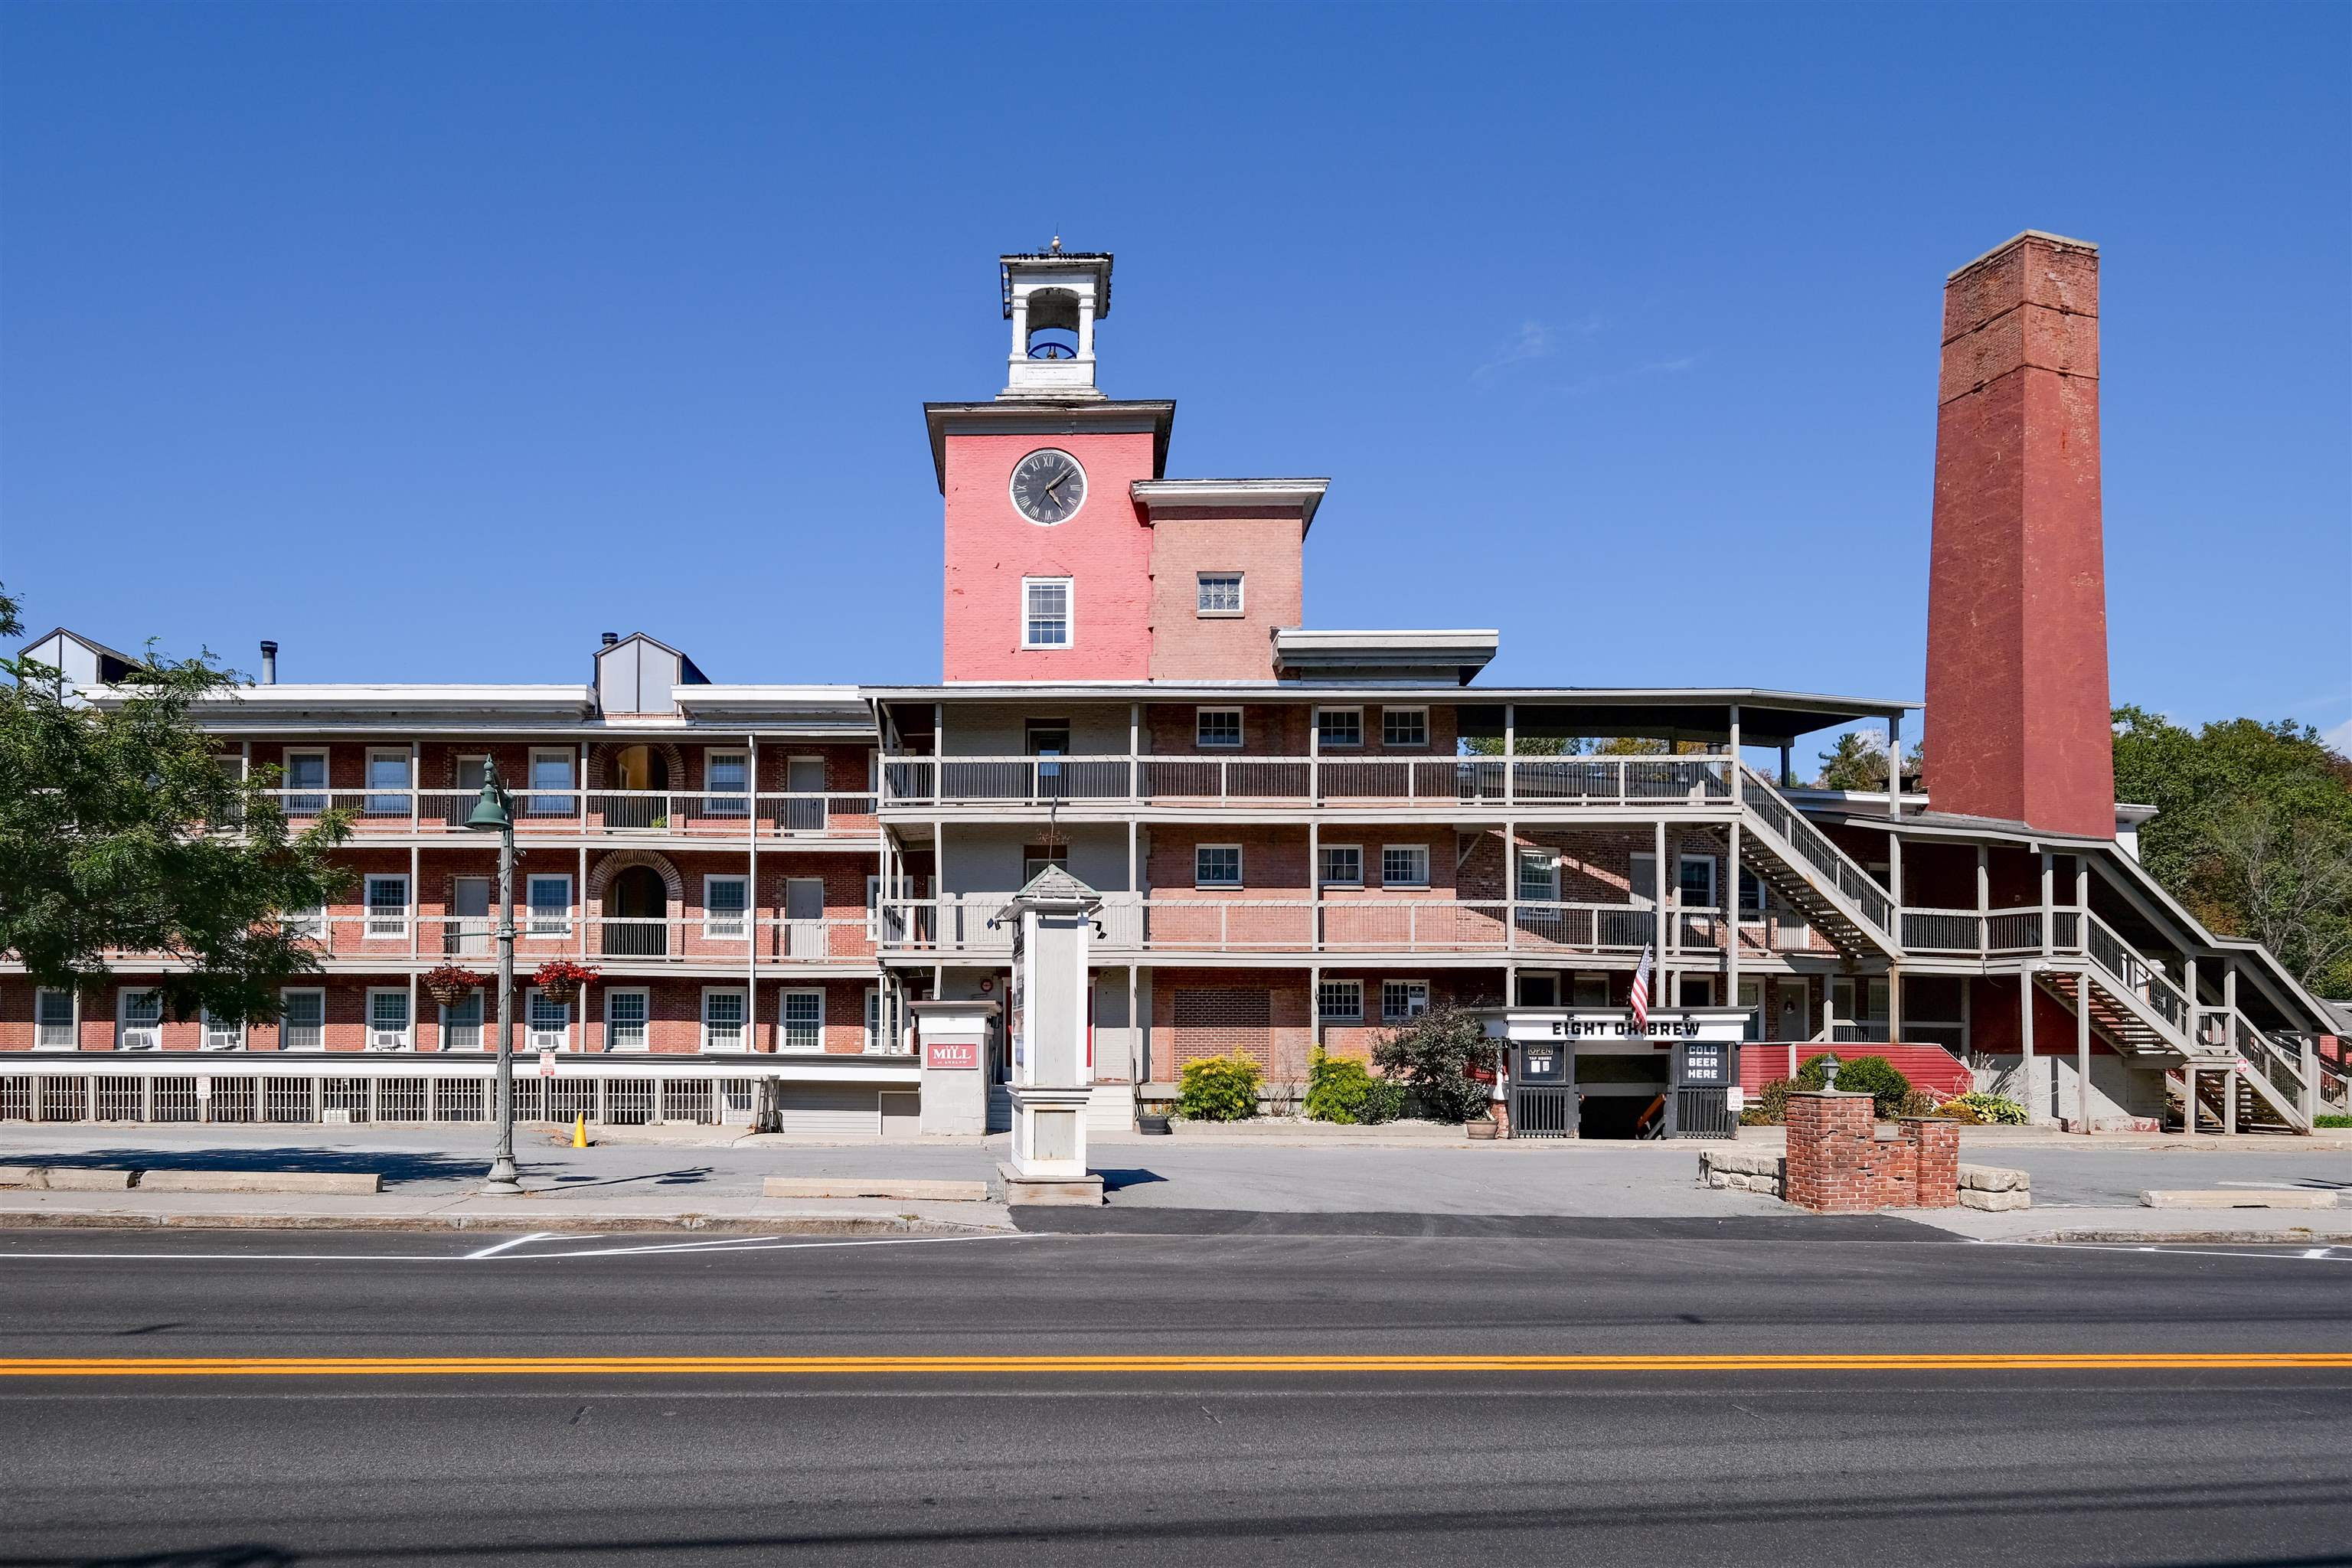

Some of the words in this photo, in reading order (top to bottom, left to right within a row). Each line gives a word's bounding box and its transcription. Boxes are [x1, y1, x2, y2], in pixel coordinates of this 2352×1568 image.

[1029, 459, 1040, 472] XI
[1043, 456, 1054, 467] XII
[1019, 470, 1031, 480] X
[1552, 1022, 1607, 1035] EIGHT
[1615, 1022, 1638, 1035] OH
[1647, 1022, 1700, 1035] BREW
[933, 1049, 972, 1060] MILL
[1688, 1046, 1717, 1055] COLD
[1688, 1058, 1718, 1067] BEER
[1687, 1070, 1718, 1079] HERE
